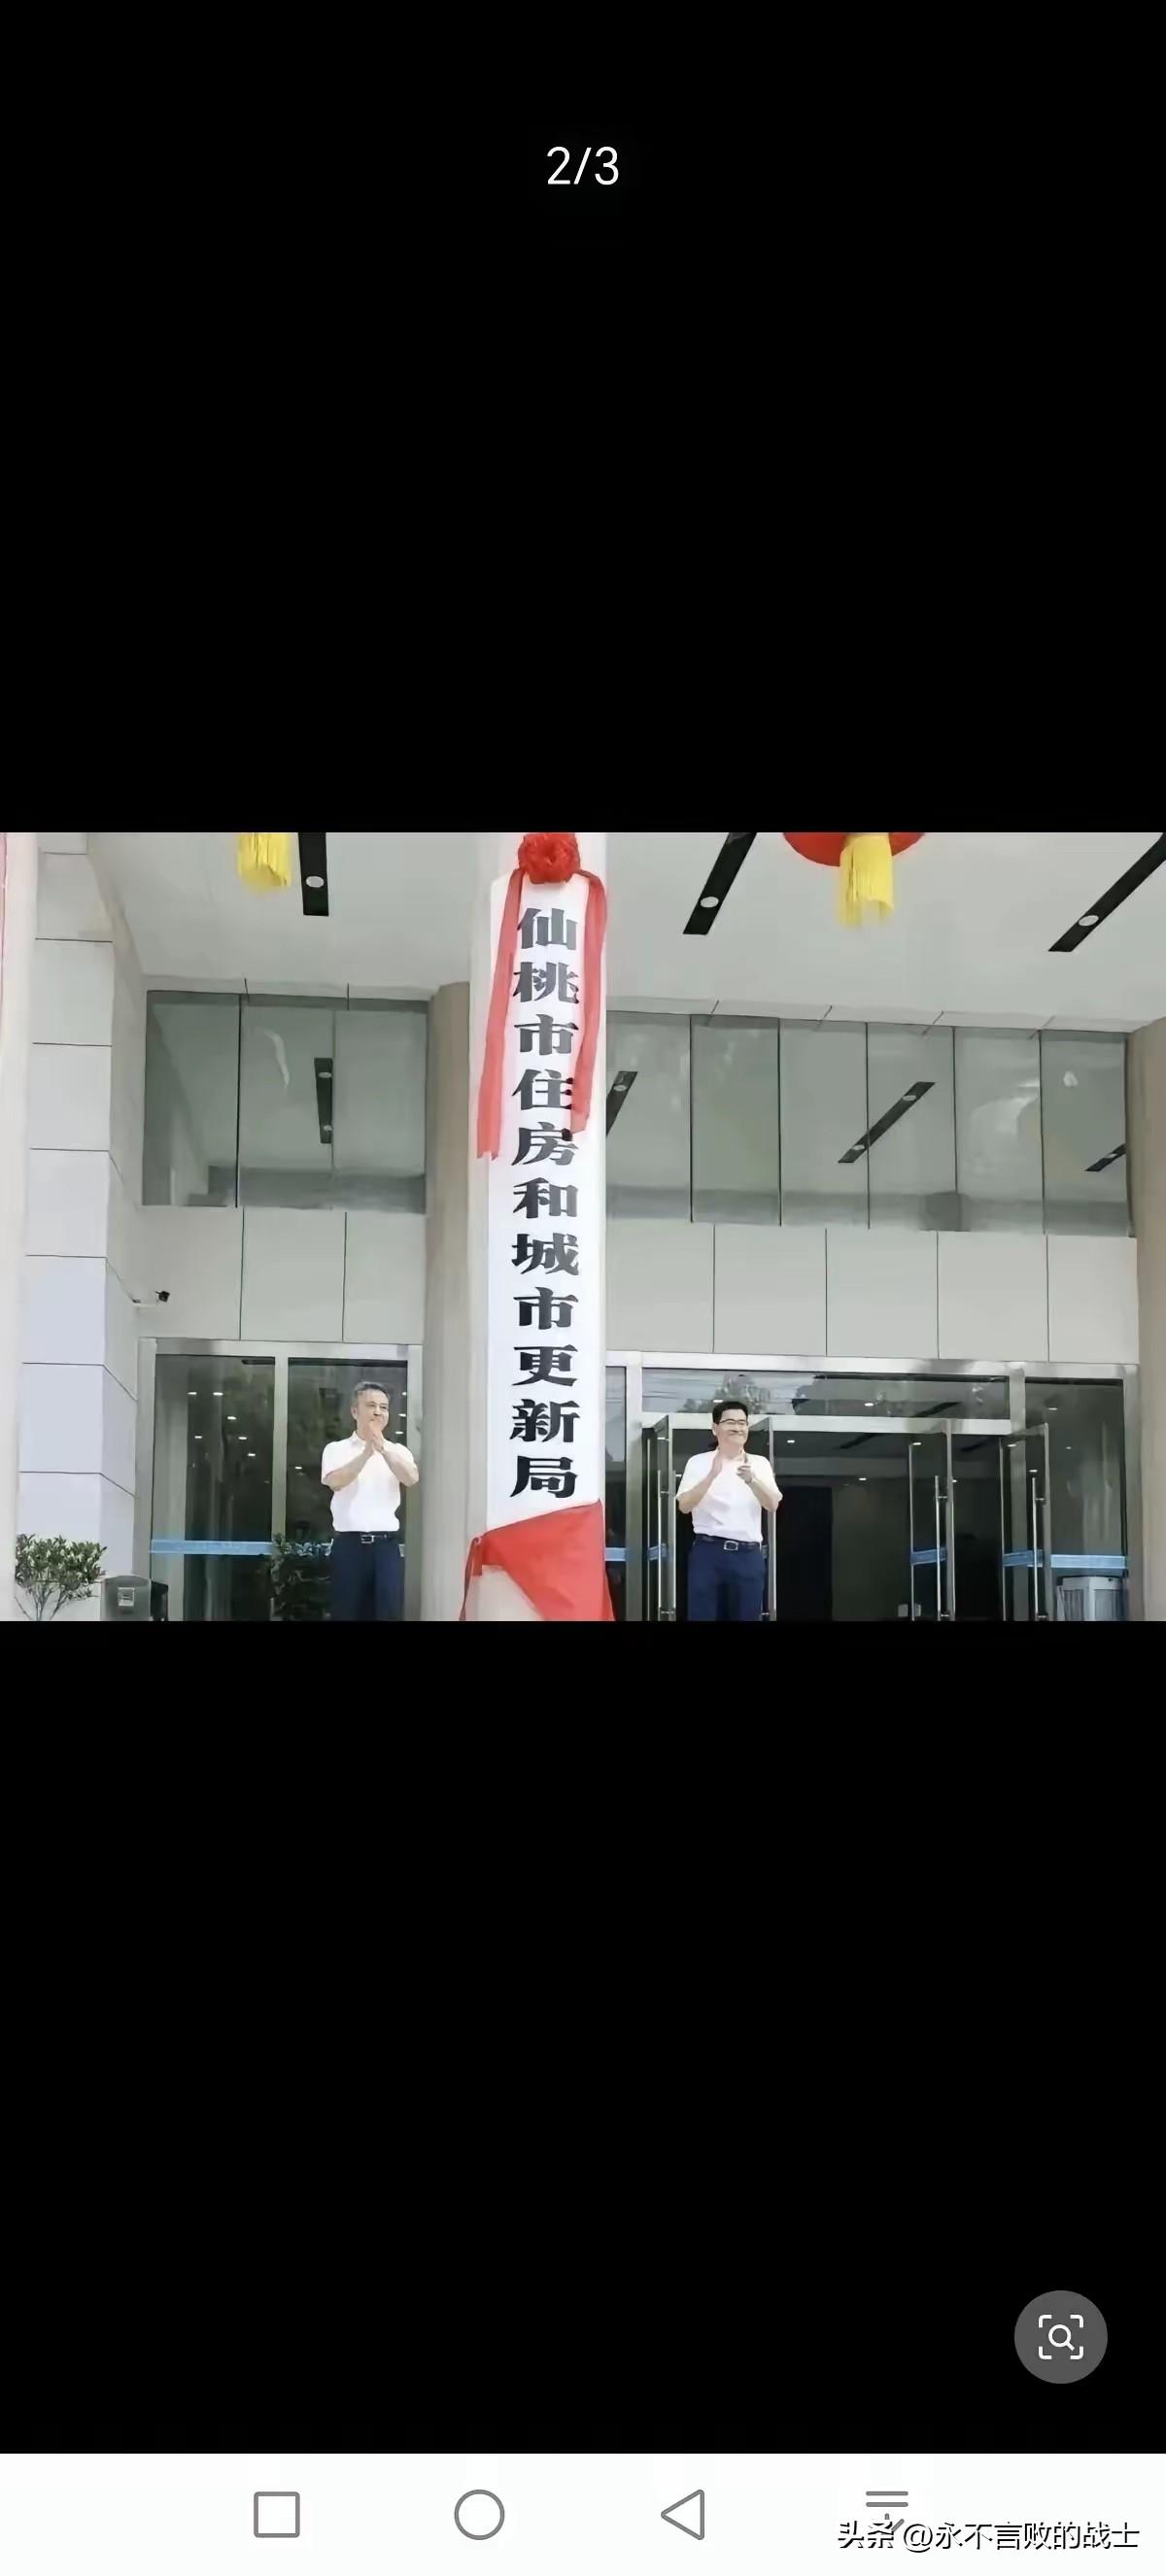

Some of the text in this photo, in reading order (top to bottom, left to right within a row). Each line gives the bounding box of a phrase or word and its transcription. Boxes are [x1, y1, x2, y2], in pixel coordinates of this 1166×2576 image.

[509, 906, 582, 1499] 仙桃市住房和城市更新局
